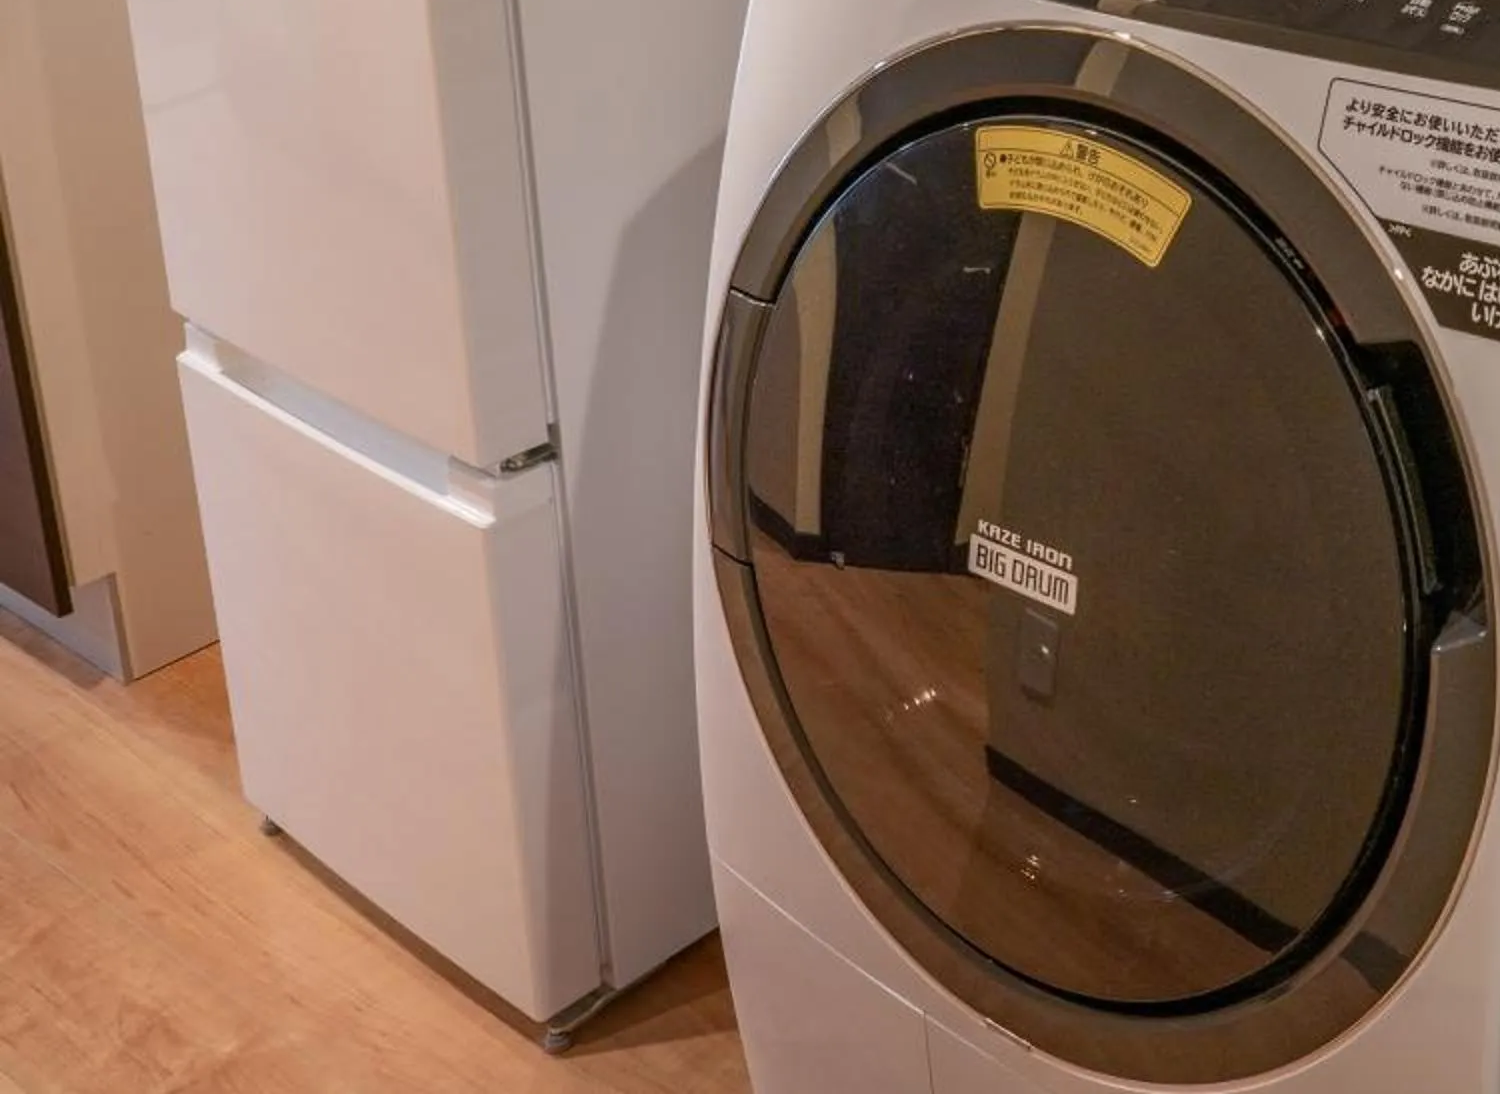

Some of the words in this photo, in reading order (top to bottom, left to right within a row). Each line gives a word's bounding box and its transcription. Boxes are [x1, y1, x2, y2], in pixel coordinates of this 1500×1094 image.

[978, 518, 1021, 549] KAZE
[1026, 539, 1073, 571] IRON
[975, 544, 1006, 578] BIG
[1011, 559, 1069, 606] DRUM
